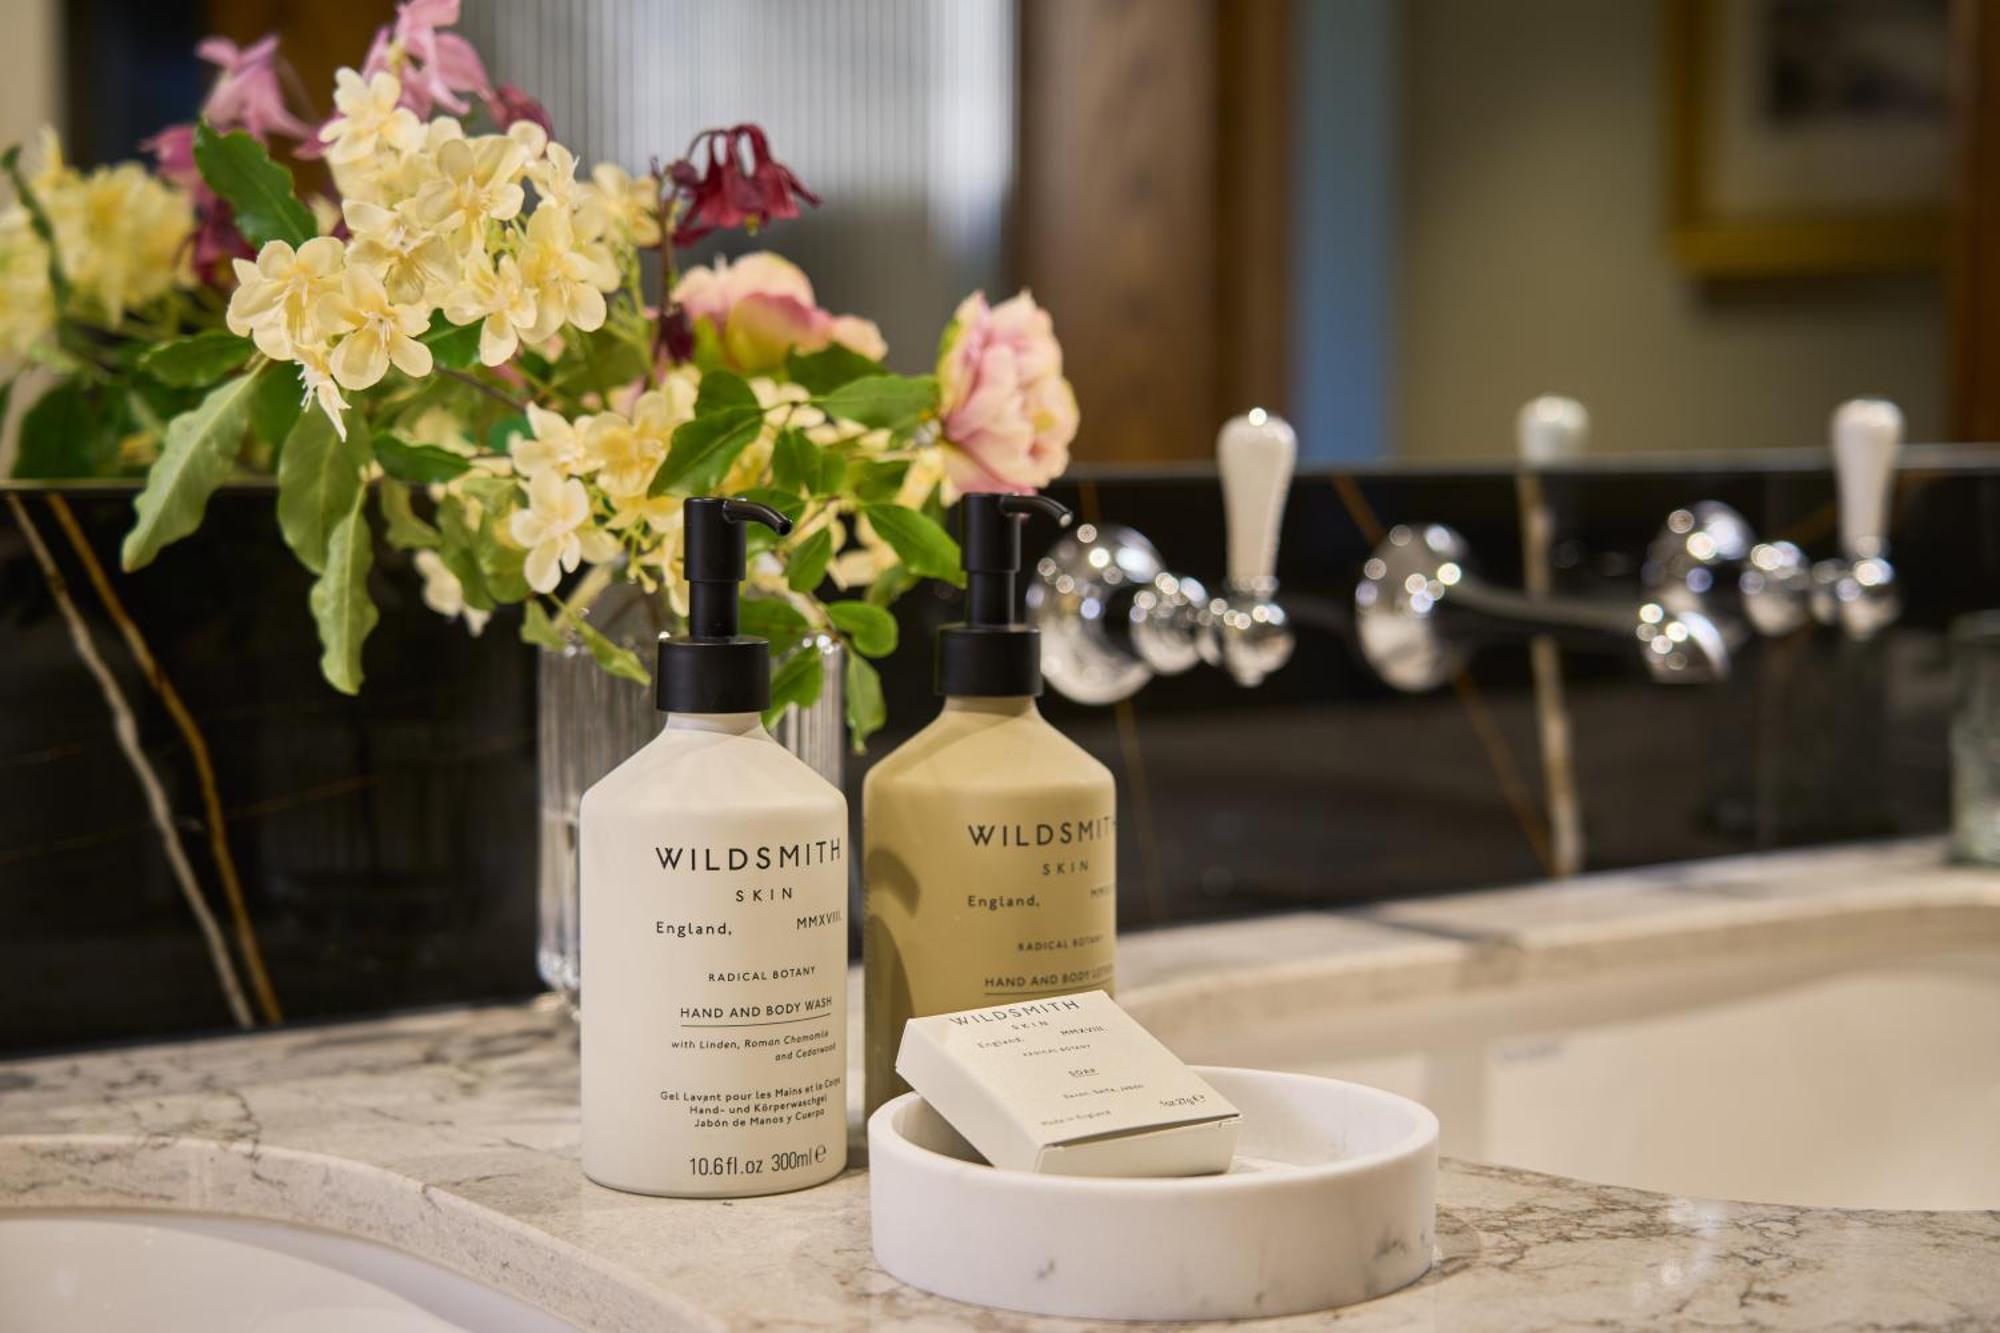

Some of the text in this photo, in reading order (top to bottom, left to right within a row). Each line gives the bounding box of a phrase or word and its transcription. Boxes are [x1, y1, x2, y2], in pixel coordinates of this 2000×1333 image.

[968, 816, 1114, 847] WILDSMIT
[656, 838, 840, 871] WILDSMITH
[1043, 861, 1089, 875] SKIN
[736, 888, 792, 902] SKIN
[968, 895, 1040, 911] England,
[656, 921, 732, 937] England,
[708, 966, 816, 982] RADICAL BOTANY
[985, 976, 1025, 988] HAND
[1031, 974, 1058, 986] AND
[680, 996, 832, 1018] HAND AND BODY WASH
[948, 1000, 1080, 1026] WILDSMITH
[671, 1040, 696, 1049] with
[700, 1040, 740, 1050] Linden,
[744, 1038, 781, 1048] Roman
[775, 1051, 792, 1061] and
[660, 1090, 680, 1101] Gel
[684, 1092, 721, 1102] Lavant
[726, 1092, 752, 1103] pour
[756, 1090, 771, 1099] les
[775, 1086, 802, 1098] Mains
[690, 1105, 725, 1115] Hand-
[729, 1104, 750, 1114] und
[694, 1108, 825, 1127] Jabón de Manos y Cuerpo
